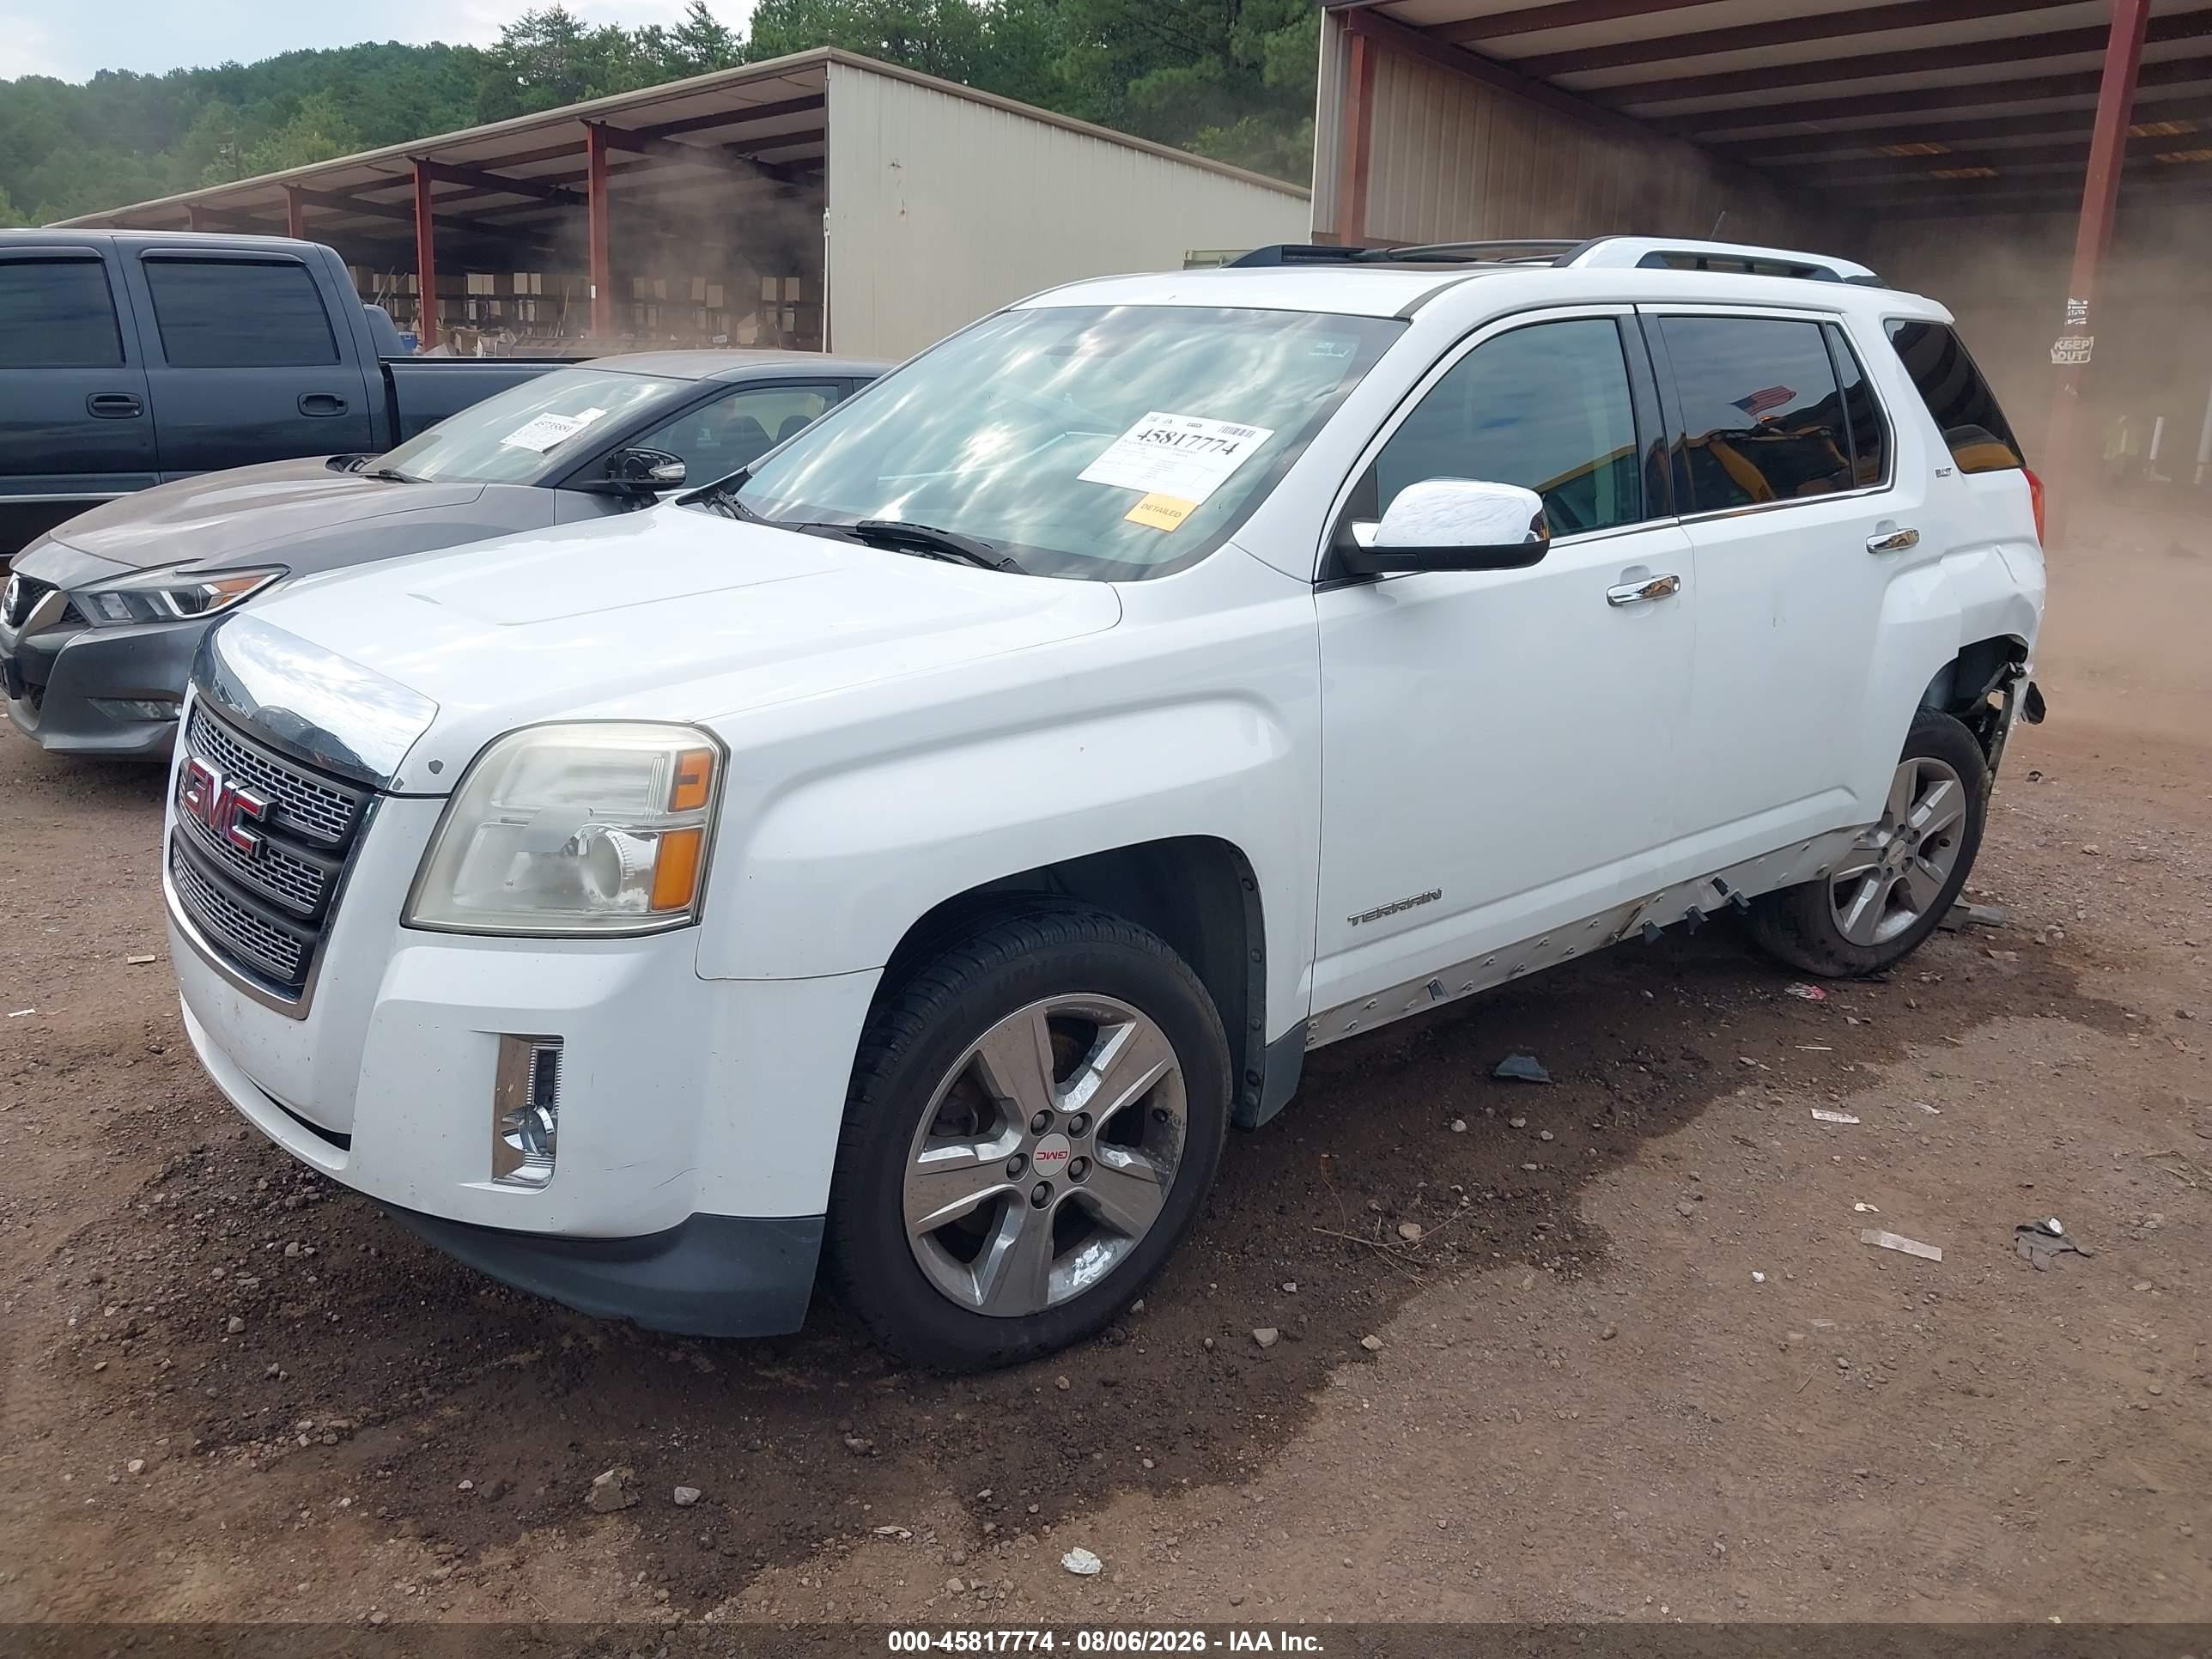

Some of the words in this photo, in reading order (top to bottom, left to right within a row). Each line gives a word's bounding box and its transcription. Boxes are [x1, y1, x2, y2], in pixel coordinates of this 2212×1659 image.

[1136, 428, 1241, 456] 45817774
[1140, 502, 1182, 519] DETAILED
[184, 757, 268, 856] GMC
[1346, 886, 1443, 927] TERRAIN
[1036, 1151, 1067, 1161] GMC
